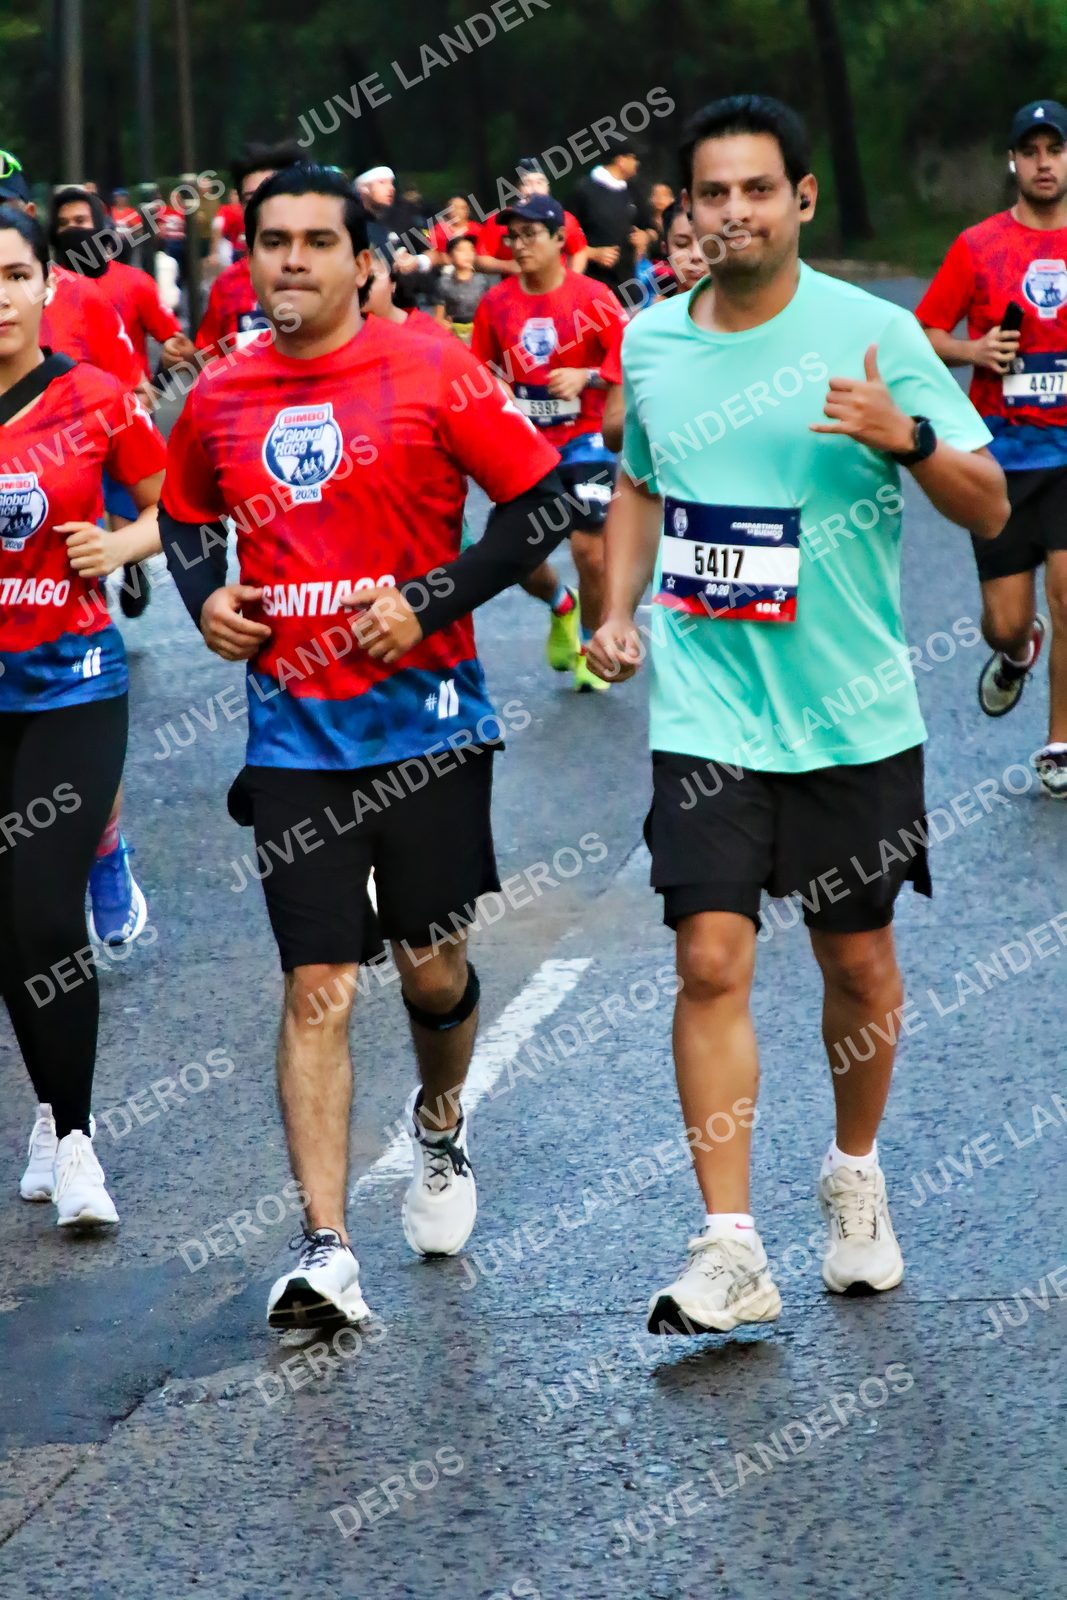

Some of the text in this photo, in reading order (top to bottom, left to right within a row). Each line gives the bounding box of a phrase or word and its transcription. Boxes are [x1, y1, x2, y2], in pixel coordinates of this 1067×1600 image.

[1030, 375, 1064, 392] 4477
[284, 412, 324, 424] BIMBO
[283, 425, 324, 442] Global
[274, 441, 308, 456] Race
[694, 544, 745, 578] 5417
